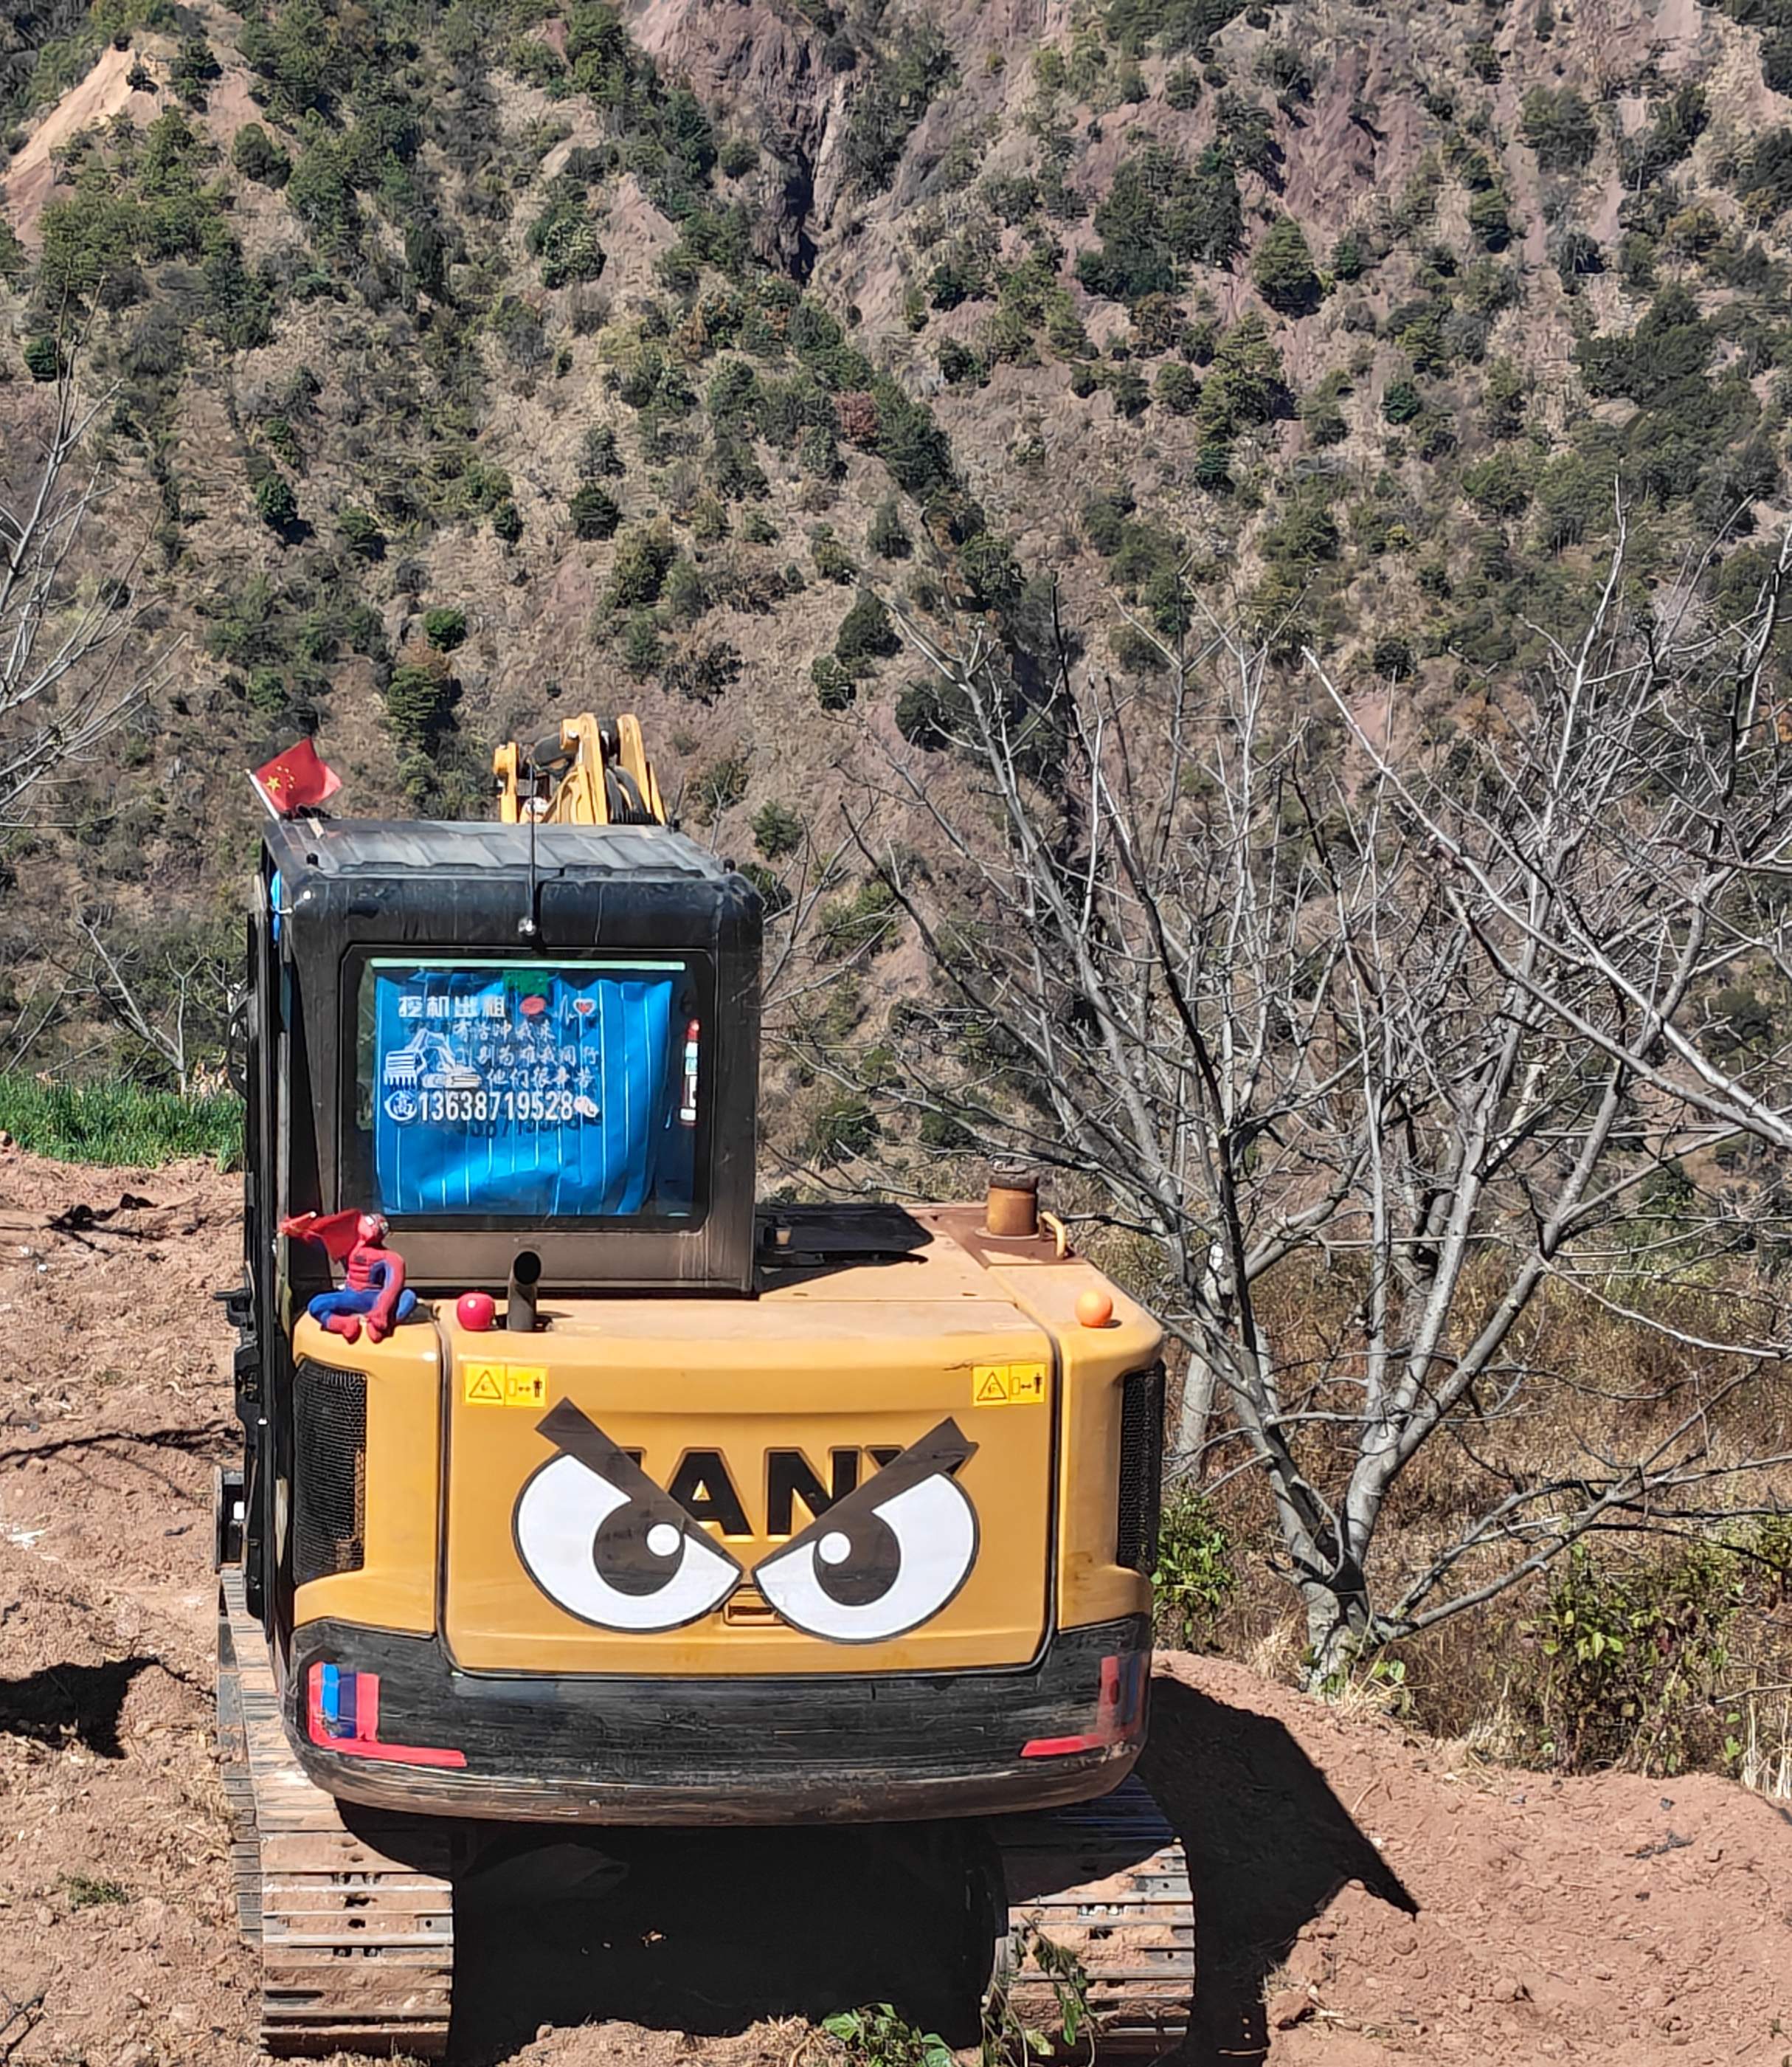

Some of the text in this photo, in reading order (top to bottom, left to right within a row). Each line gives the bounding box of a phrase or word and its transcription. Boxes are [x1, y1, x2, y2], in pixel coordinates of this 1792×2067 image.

[398, 995, 506, 1018] 挖机出租
[487, 1068, 595, 1091] 他们很辛苦
[419, 1091, 573, 1122] 13638719528
[621, 1448, 968, 1538] AN
